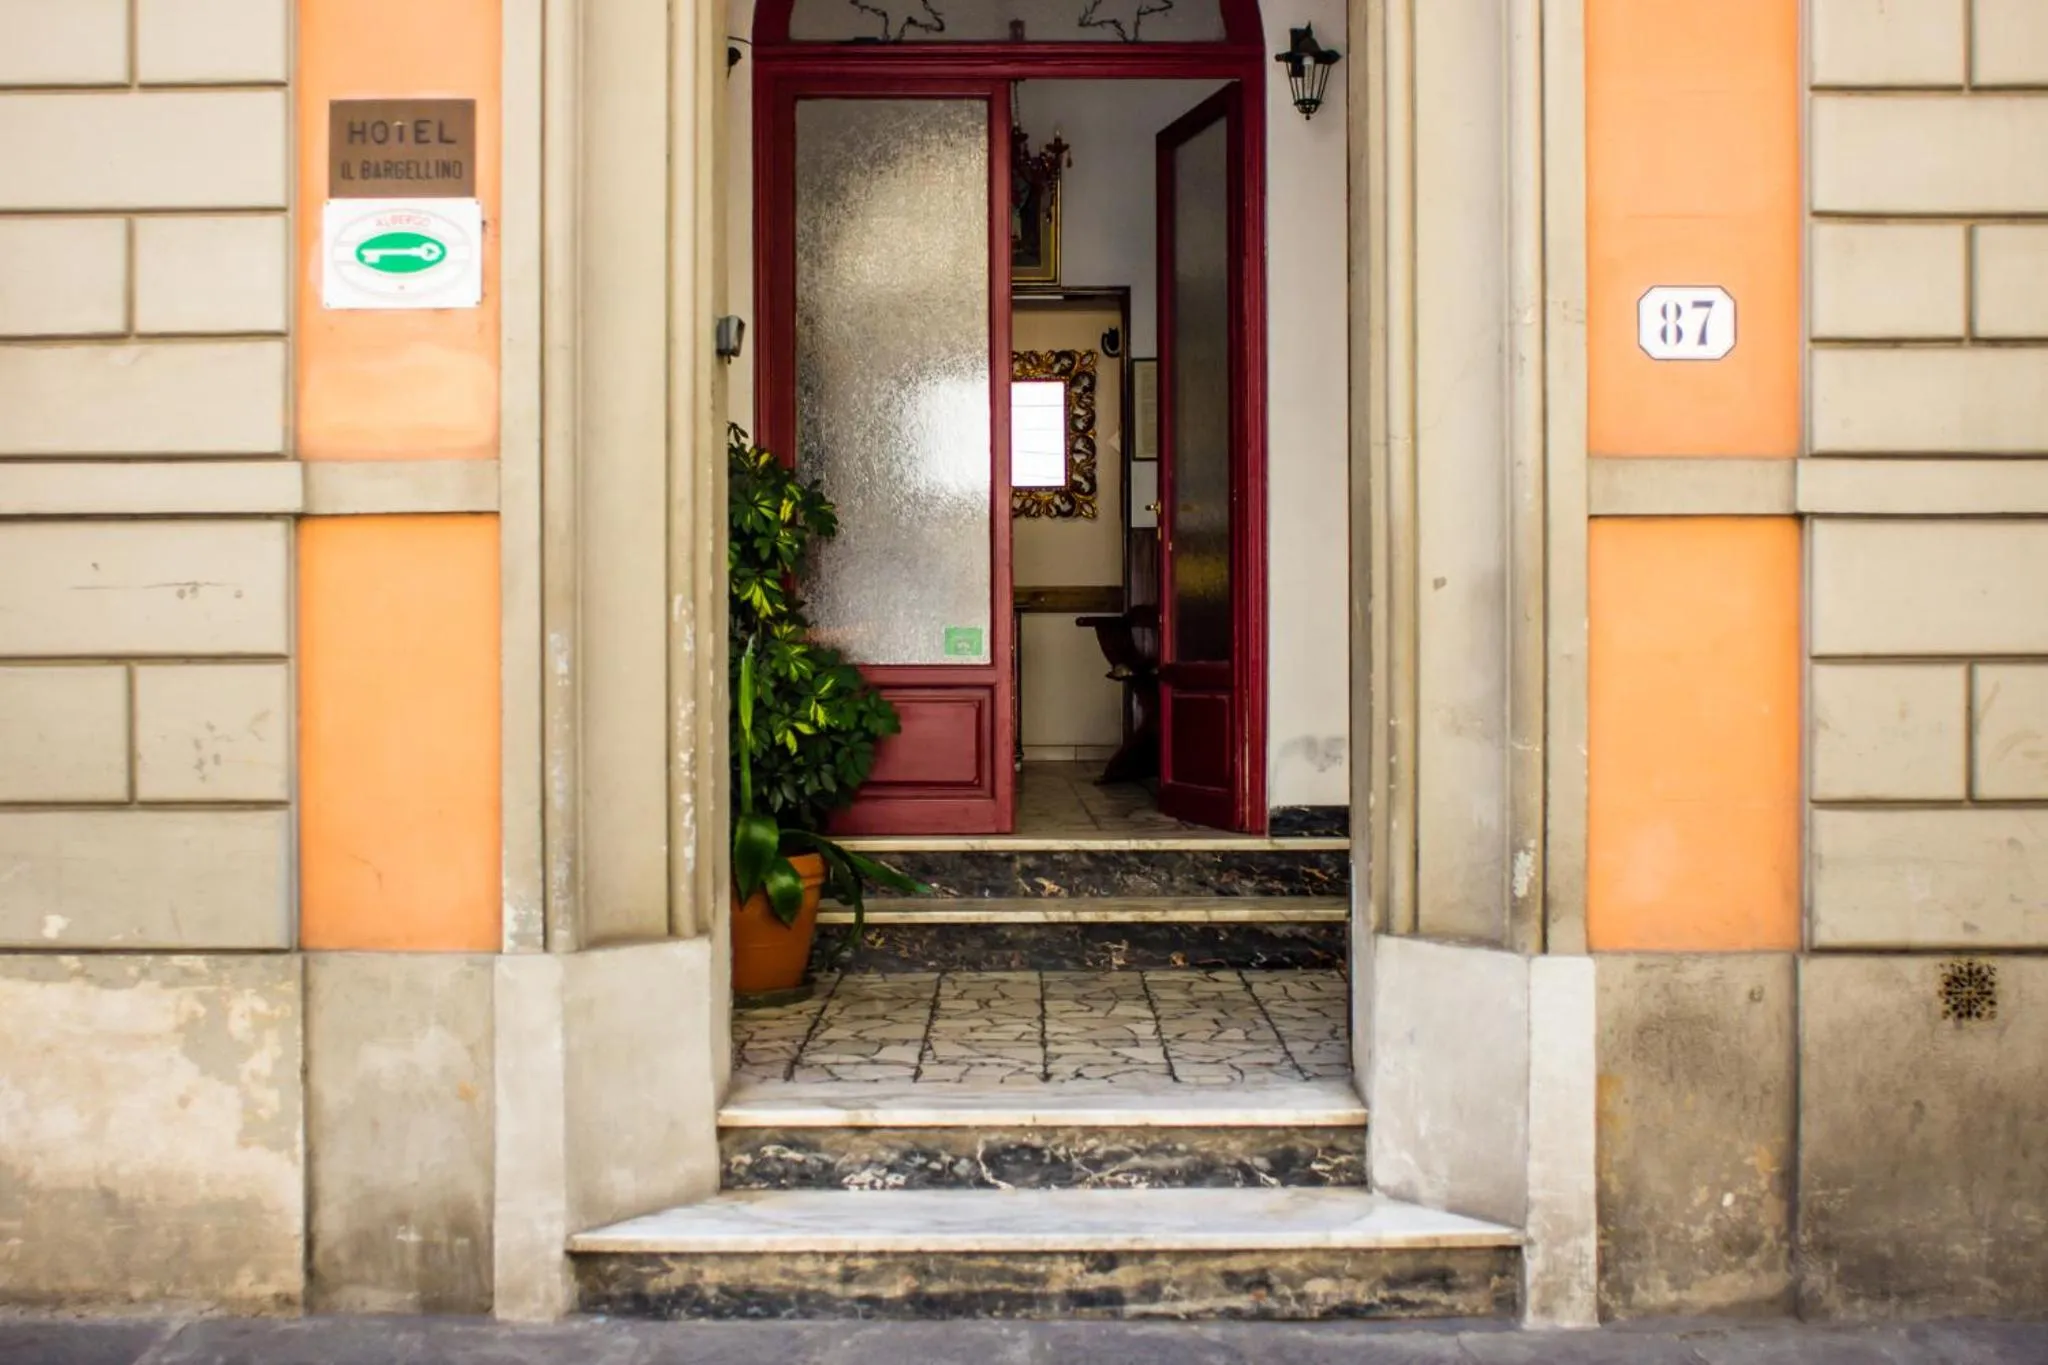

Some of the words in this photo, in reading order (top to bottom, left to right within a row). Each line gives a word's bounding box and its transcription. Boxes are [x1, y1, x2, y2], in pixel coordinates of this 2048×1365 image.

[348, 120, 456, 144] HOTEL
[341, 161, 354, 180] IL
[361, 160, 463, 180] BARGELLINO
[1660, 300, 1715, 346] 87
